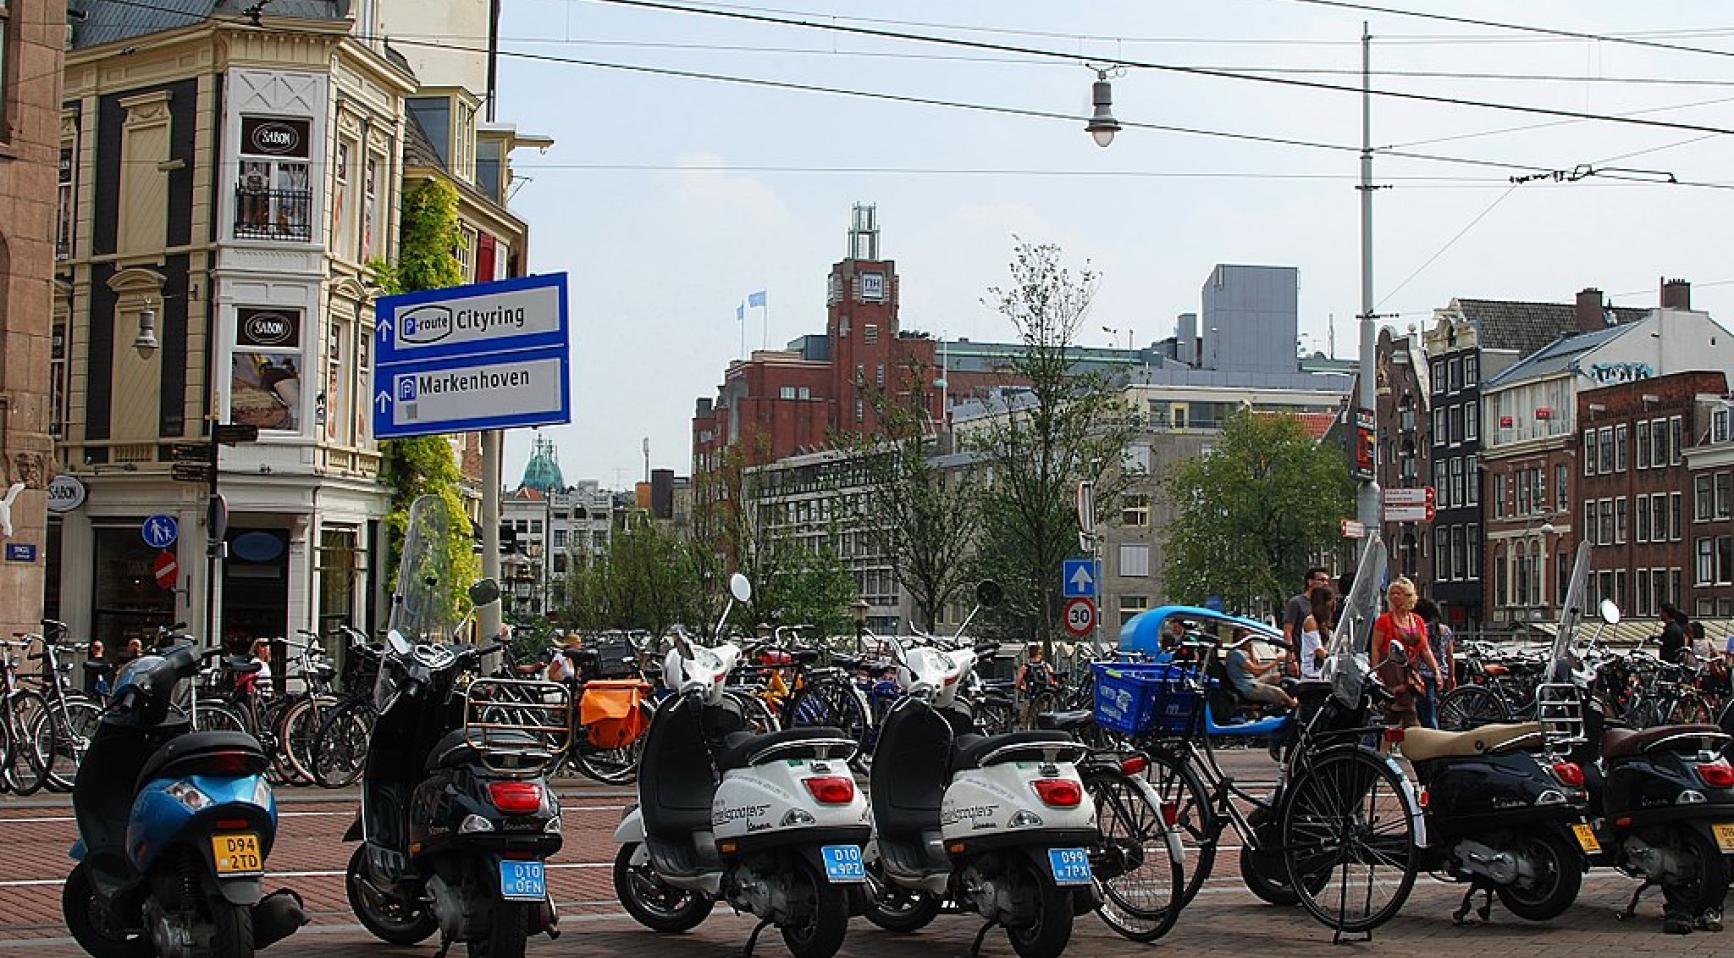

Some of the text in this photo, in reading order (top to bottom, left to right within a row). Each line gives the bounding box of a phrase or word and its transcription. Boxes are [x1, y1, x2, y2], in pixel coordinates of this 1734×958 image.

[261, 130, 290, 144] SABON
[456, 306, 524, 332] Cityring
[255, 321, 284, 335] SABON
[419, 369, 529, 395] Markenhoven
[48, 485, 77, 500] SABON
[1070, 609, 1090, 624] 30
[227, 838, 255, 852] D94
[230, 855, 258, 869] 2TD
[834, 849, 858, 861] D10
[1061, 851, 1083, 863] D99
[515, 865, 541, 878] D10
[1064, 864, 1088, 877] 7PX
